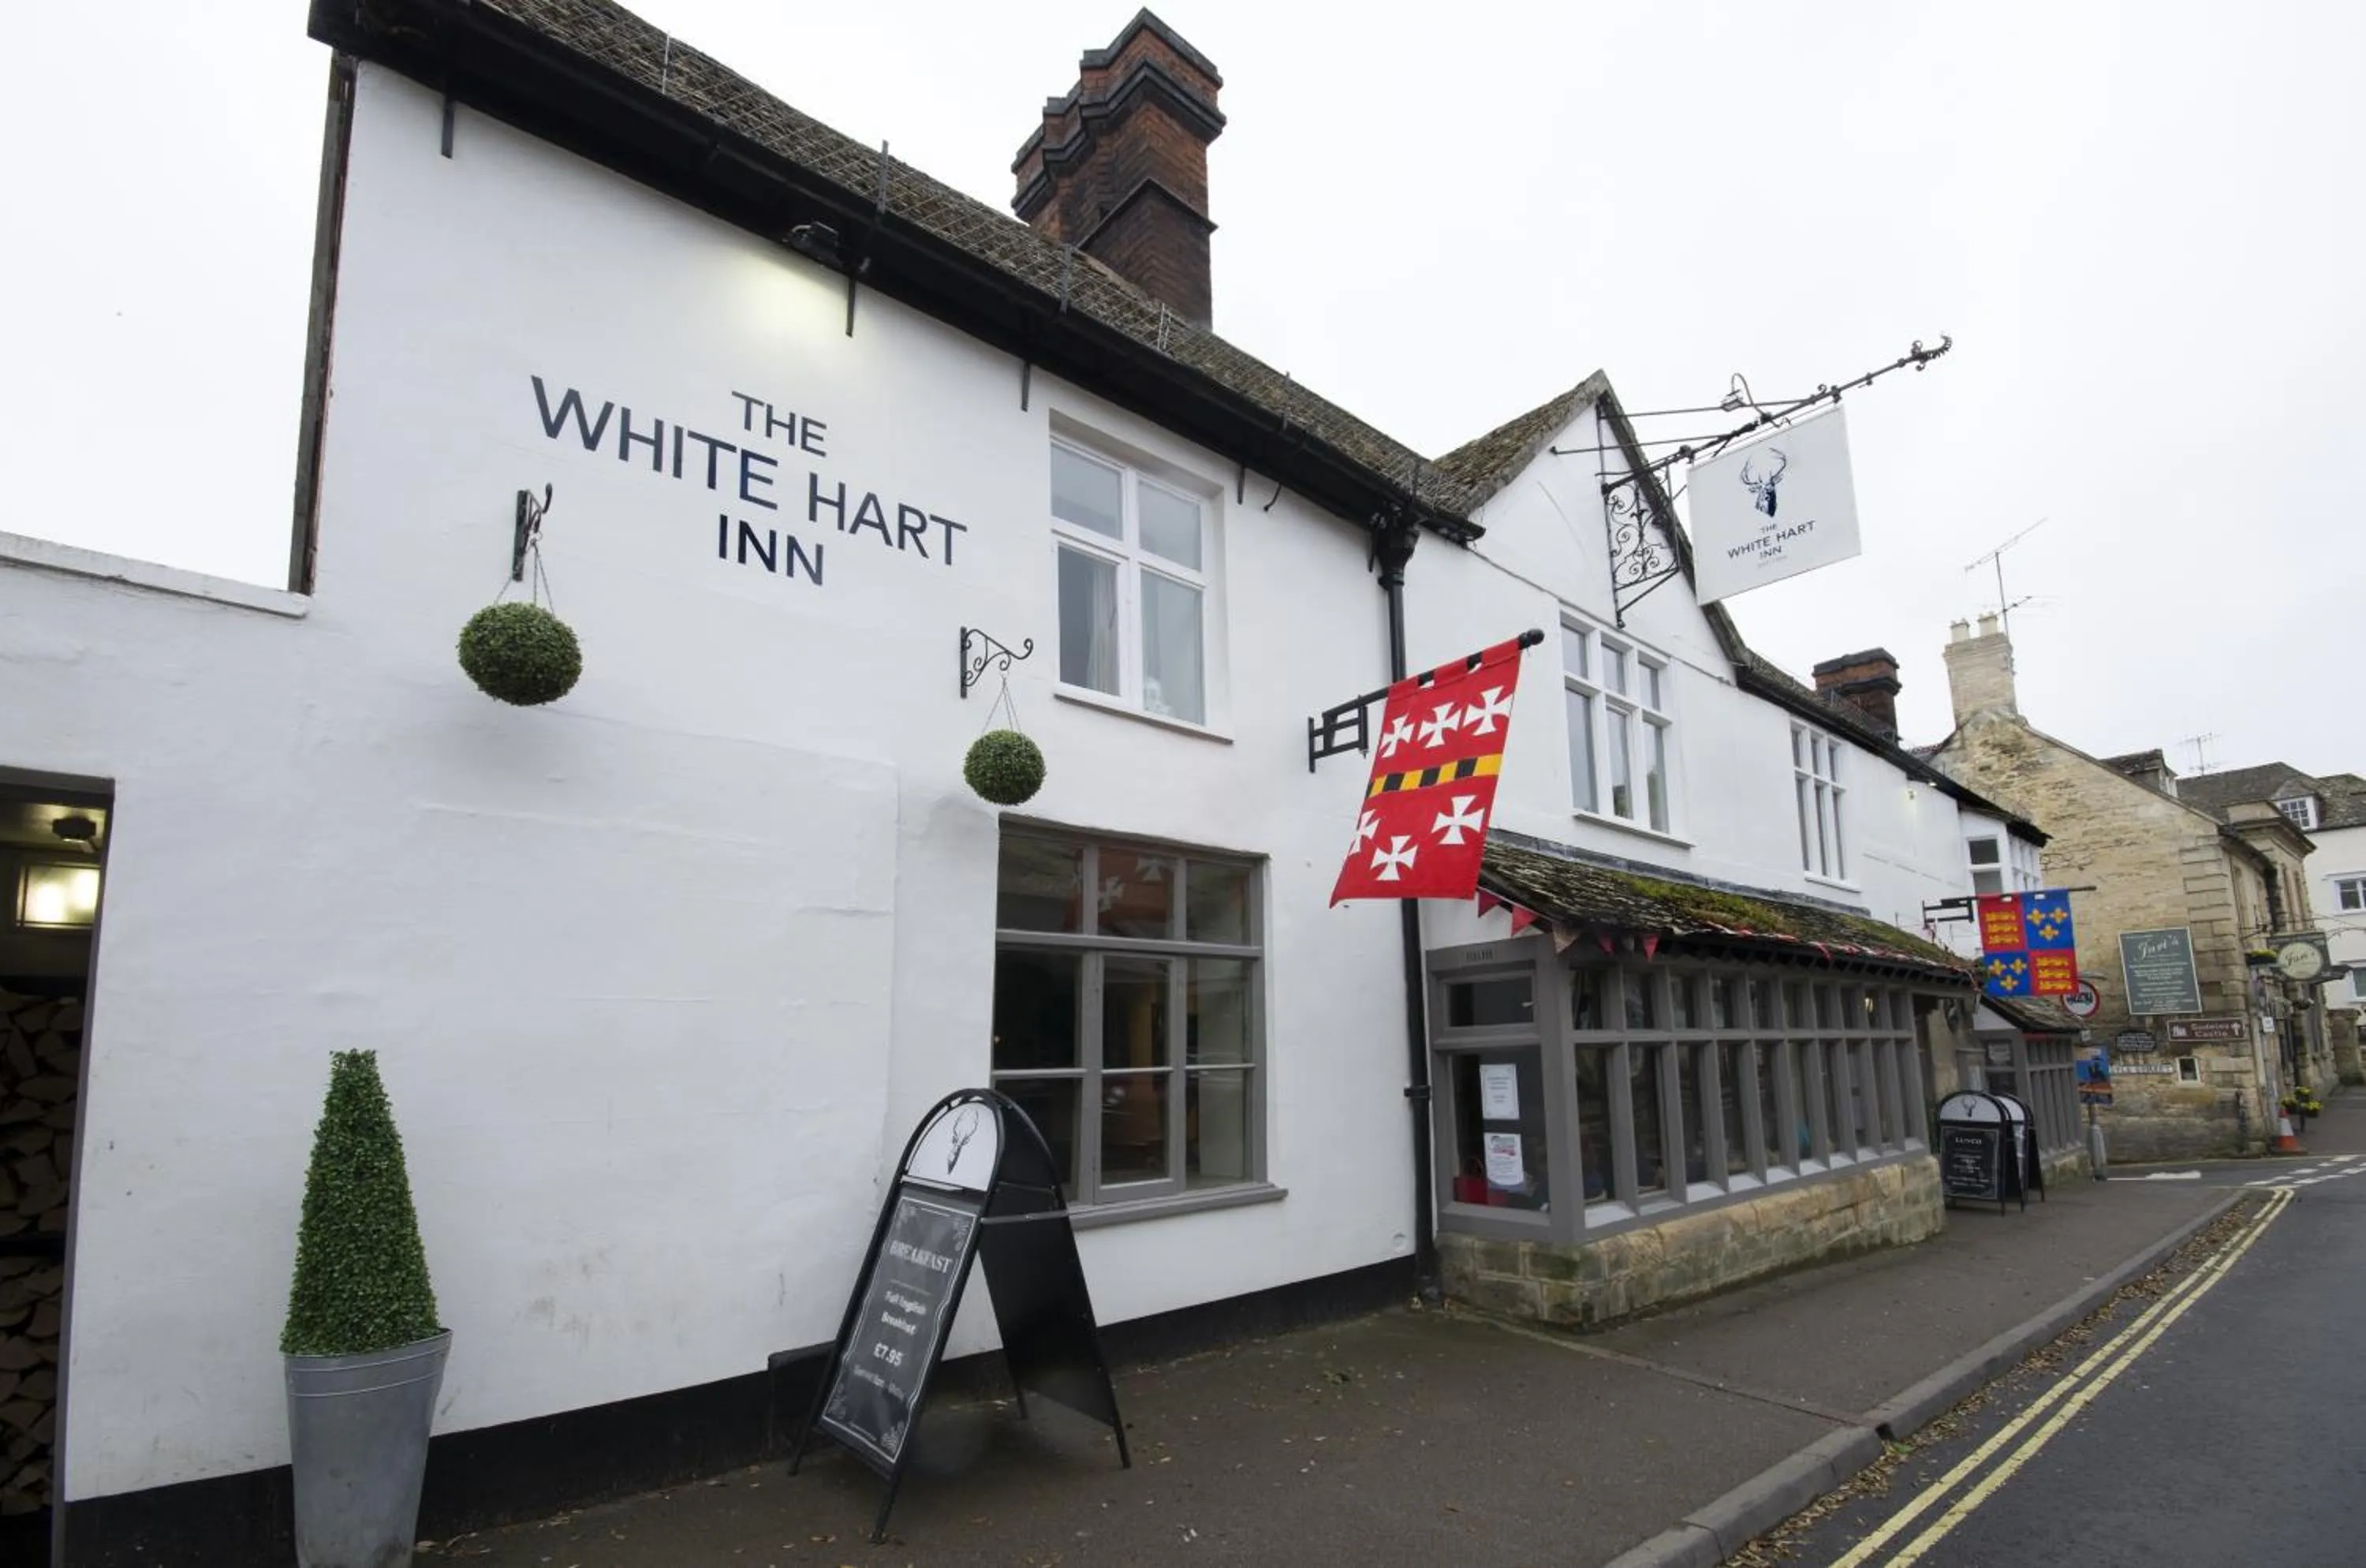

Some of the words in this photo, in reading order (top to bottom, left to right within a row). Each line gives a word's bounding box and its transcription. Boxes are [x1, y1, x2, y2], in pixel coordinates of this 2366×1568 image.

[732, 390, 827, 457] THE
[531, 375, 778, 510] WHITE
[808, 472, 967, 566] HART
[1728, 536, 1771, 558] WHITE
[1776, 521, 1816, 542] HART
[1760, 524, 1777, 533] THE
[718, 513, 823, 586] INN
[1760, 546, 1782, 559] INN
[890, 1240, 953, 1274] BREAKFAST
[874, 1342, 904, 1367] £7.95
